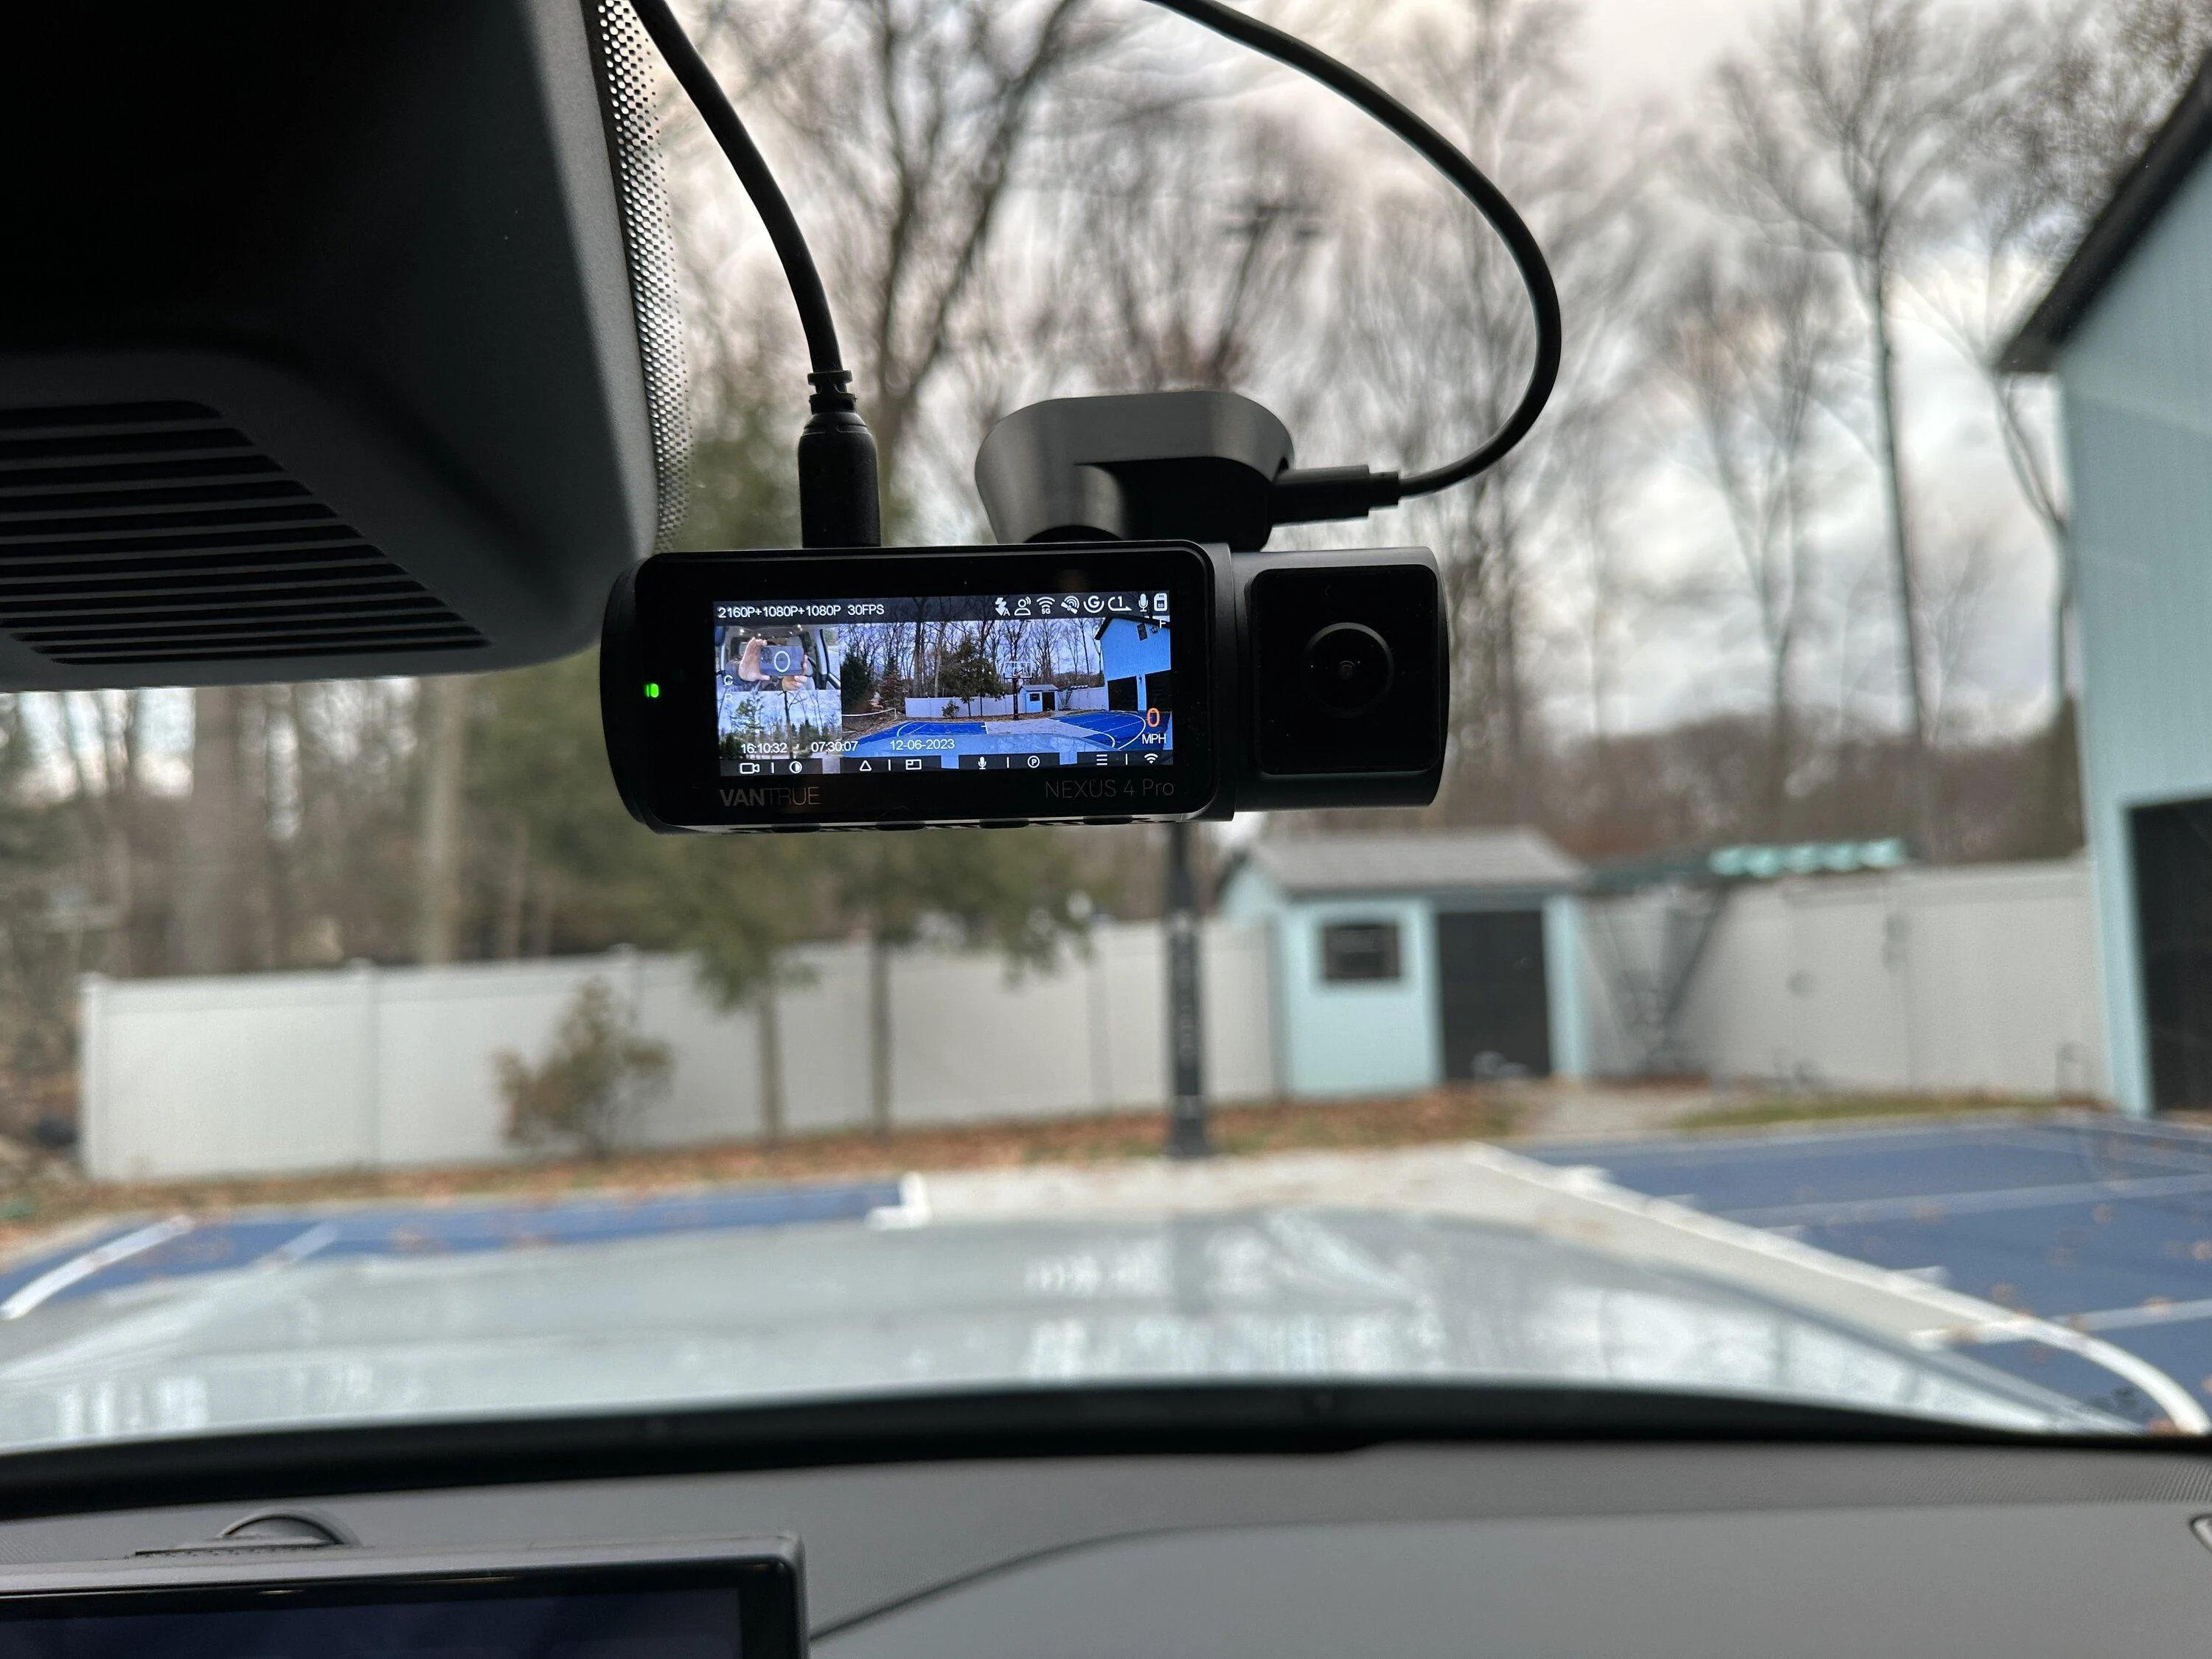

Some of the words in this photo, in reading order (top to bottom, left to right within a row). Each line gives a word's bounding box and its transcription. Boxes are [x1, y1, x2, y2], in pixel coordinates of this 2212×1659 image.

[717, 604, 841, 619] 2160P+1080P+1080P
[847, 603, 885, 616] 30FPS
[1147, 707, 1161, 728] 0
[740, 742, 787, 754] 16:10:32
[811, 740, 859, 753] 07:30:07
[890, 738, 956, 751] 12-06-2023
[1141, 733, 1166, 745] MPH
[720, 787, 821, 807] VANTRUE
[1045, 779, 1117, 799] NEXUS
[1123, 779, 1135, 796] 4
[1143, 778, 1175, 796] Pro
